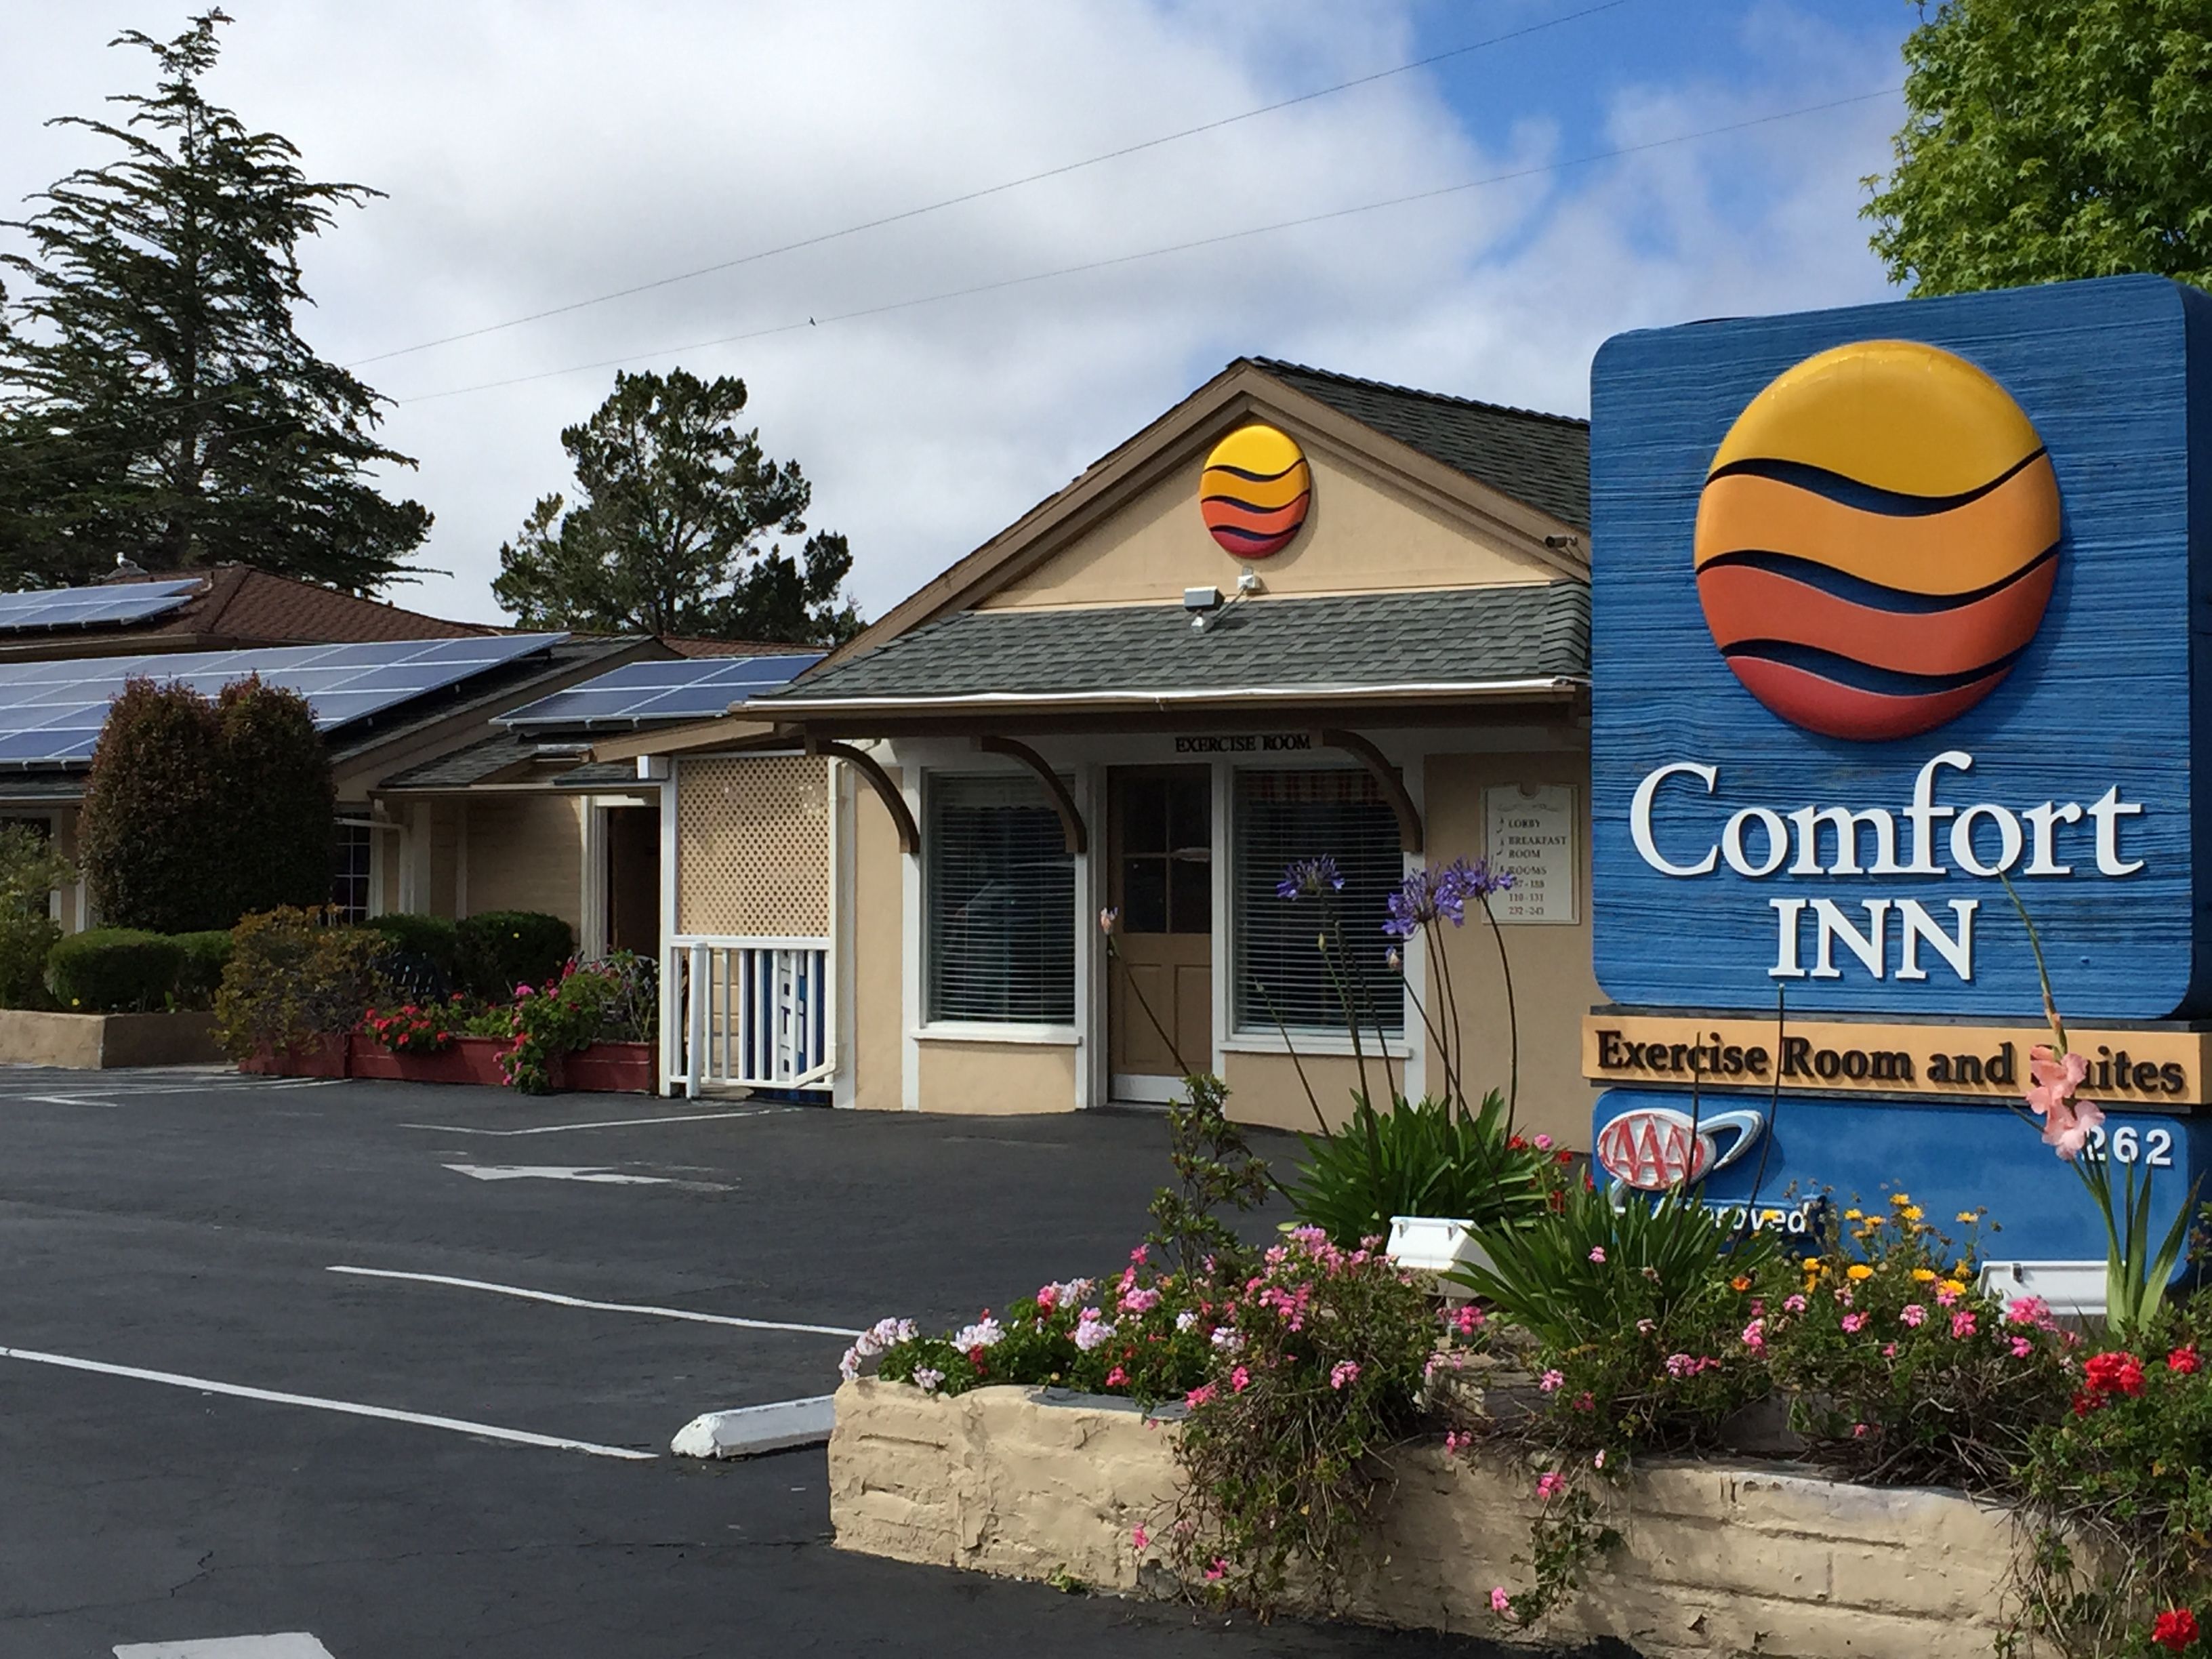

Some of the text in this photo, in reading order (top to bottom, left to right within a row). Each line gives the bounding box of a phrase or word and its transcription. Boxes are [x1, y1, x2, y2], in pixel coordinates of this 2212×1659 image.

[1175, 733, 1311, 753] EXERCISE ROOM
[1508, 819, 1540, 828] LOBBY
[1630, 750, 2145, 877] Comfort
[1509, 836, 1567, 845] BREAKFAST
[1509, 849, 1541, 859] ROOM
[1509, 865, 1547, 875] ROOMS
[1769, 899, 1979, 981] INN
[1595, 1030, 2184, 1094] Exercise Room and uites
[1612, 1113, 1692, 1186] AAA
